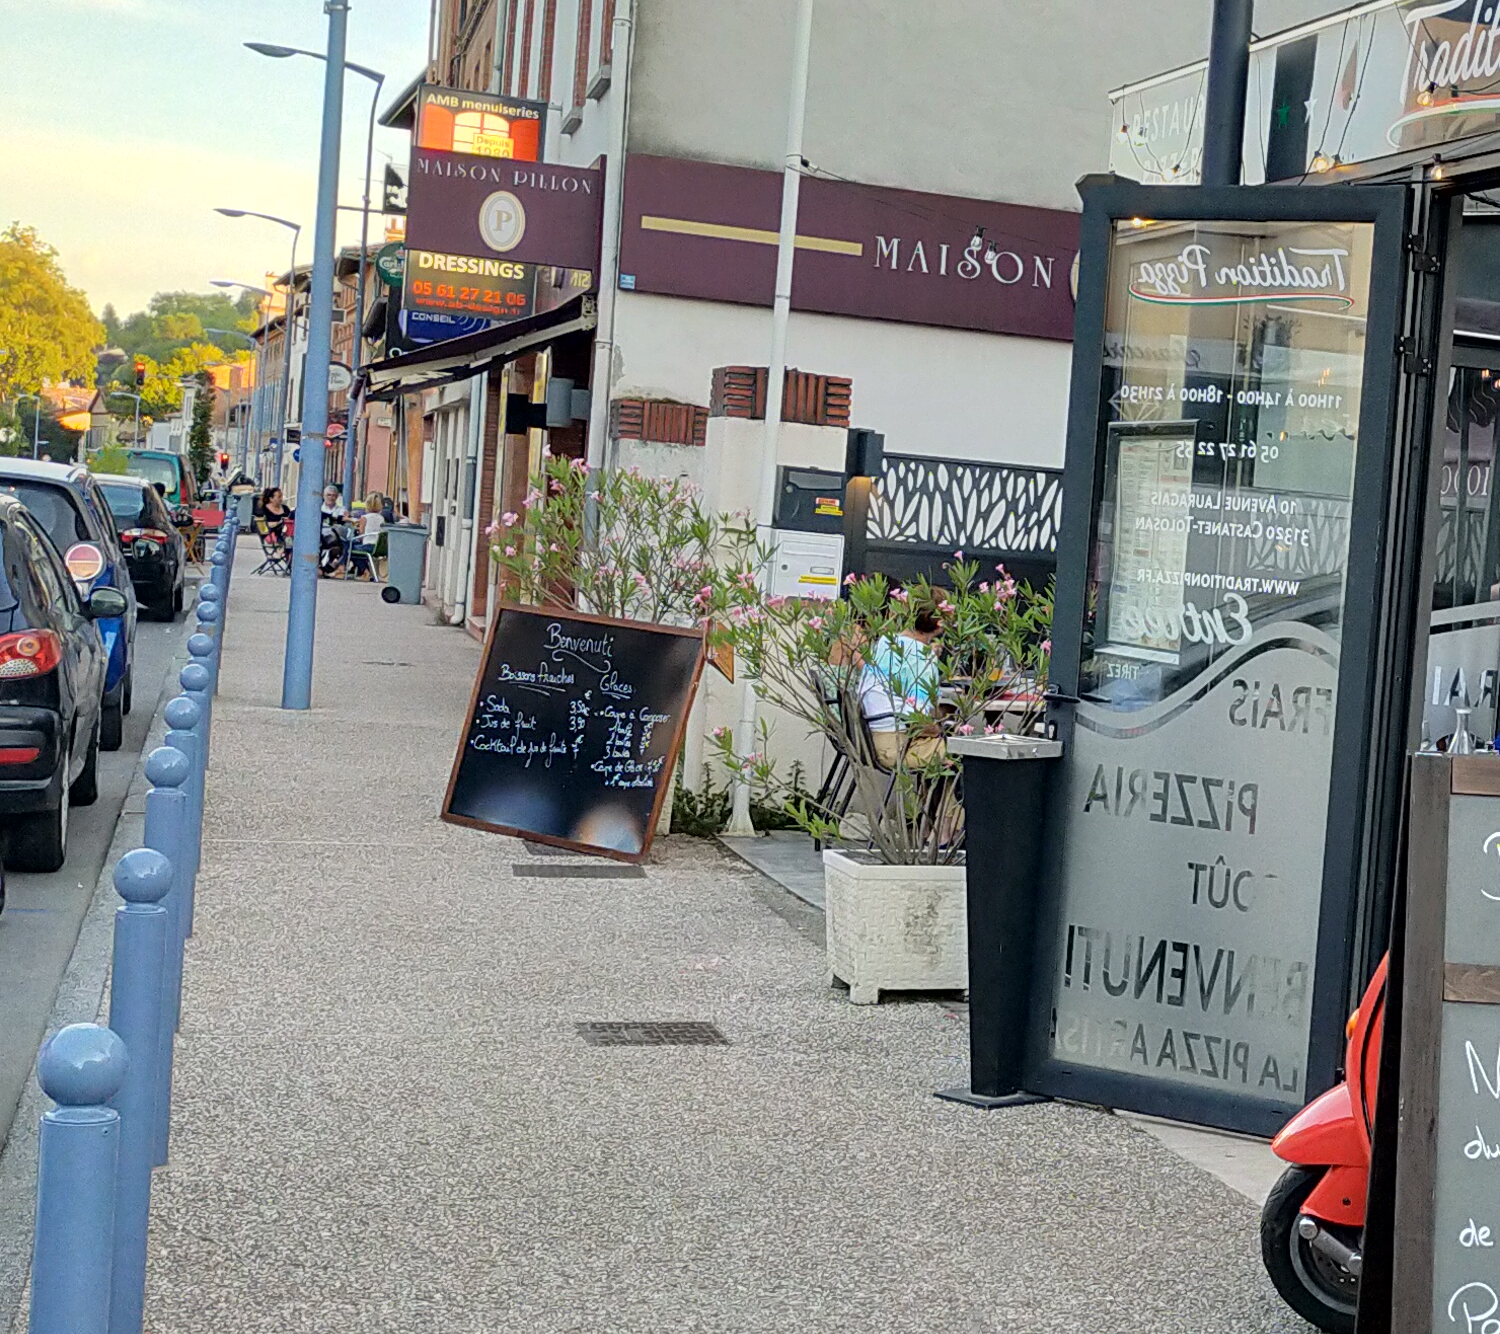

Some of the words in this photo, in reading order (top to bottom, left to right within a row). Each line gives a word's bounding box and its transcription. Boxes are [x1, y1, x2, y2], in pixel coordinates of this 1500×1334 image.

[427, 93, 459, 108] AMB
[461, 100, 540, 119] menuiseries
[476, 136, 510, 148] Depuis
[417, 158, 501, 183] MAISON
[514, 170, 592, 195] PILLON
[493, 209, 513, 232] P
[419, 252, 525, 280] DRESSINGS
[873, 235, 1055, 289] MAISON
[413, 280, 435, 295] 05
[436, 284, 456, 298] 61
[460, 287, 481, 301] 27
[484, 289, 502, 304] 21
[506, 292, 527, 306] 06
[411, 312, 456, 324] CONSEIL
[543, 622, 614, 657] Benvenuti
[486, 694, 511, 714] Soda
[500, 718, 510, 729] de
[1460, 1219, 1494, 1248] de
